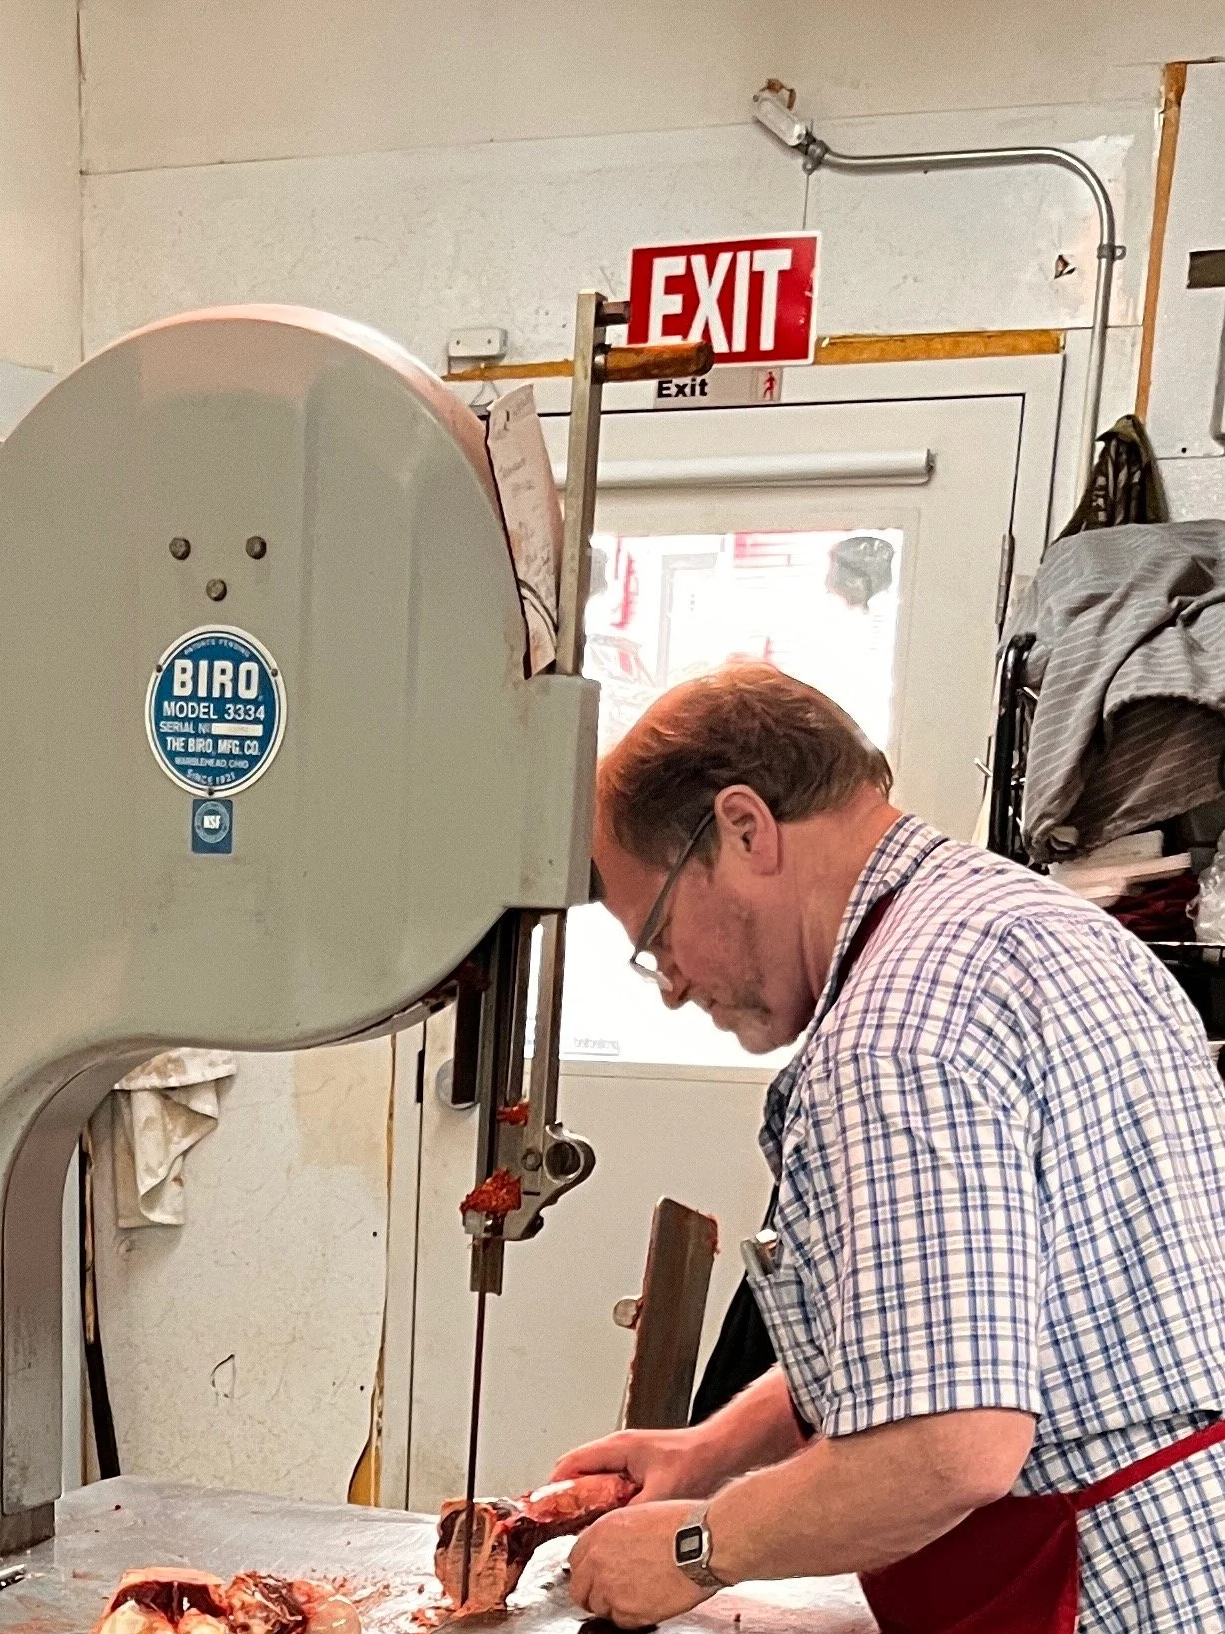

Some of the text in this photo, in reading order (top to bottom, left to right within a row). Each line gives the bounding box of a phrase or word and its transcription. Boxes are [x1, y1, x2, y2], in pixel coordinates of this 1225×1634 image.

[647, 248, 792, 353] EXIT
[657, 378, 708, 398] Exit
[173, 659, 259, 699] BIRO
[163, 701, 265, 721] MODEL 3334
[159, 721, 195, 734] SERIAL
[166, 737, 185, 752] THE
[218, 739, 243, 755] MFG.
[244, 740, 261, 756] CO.
